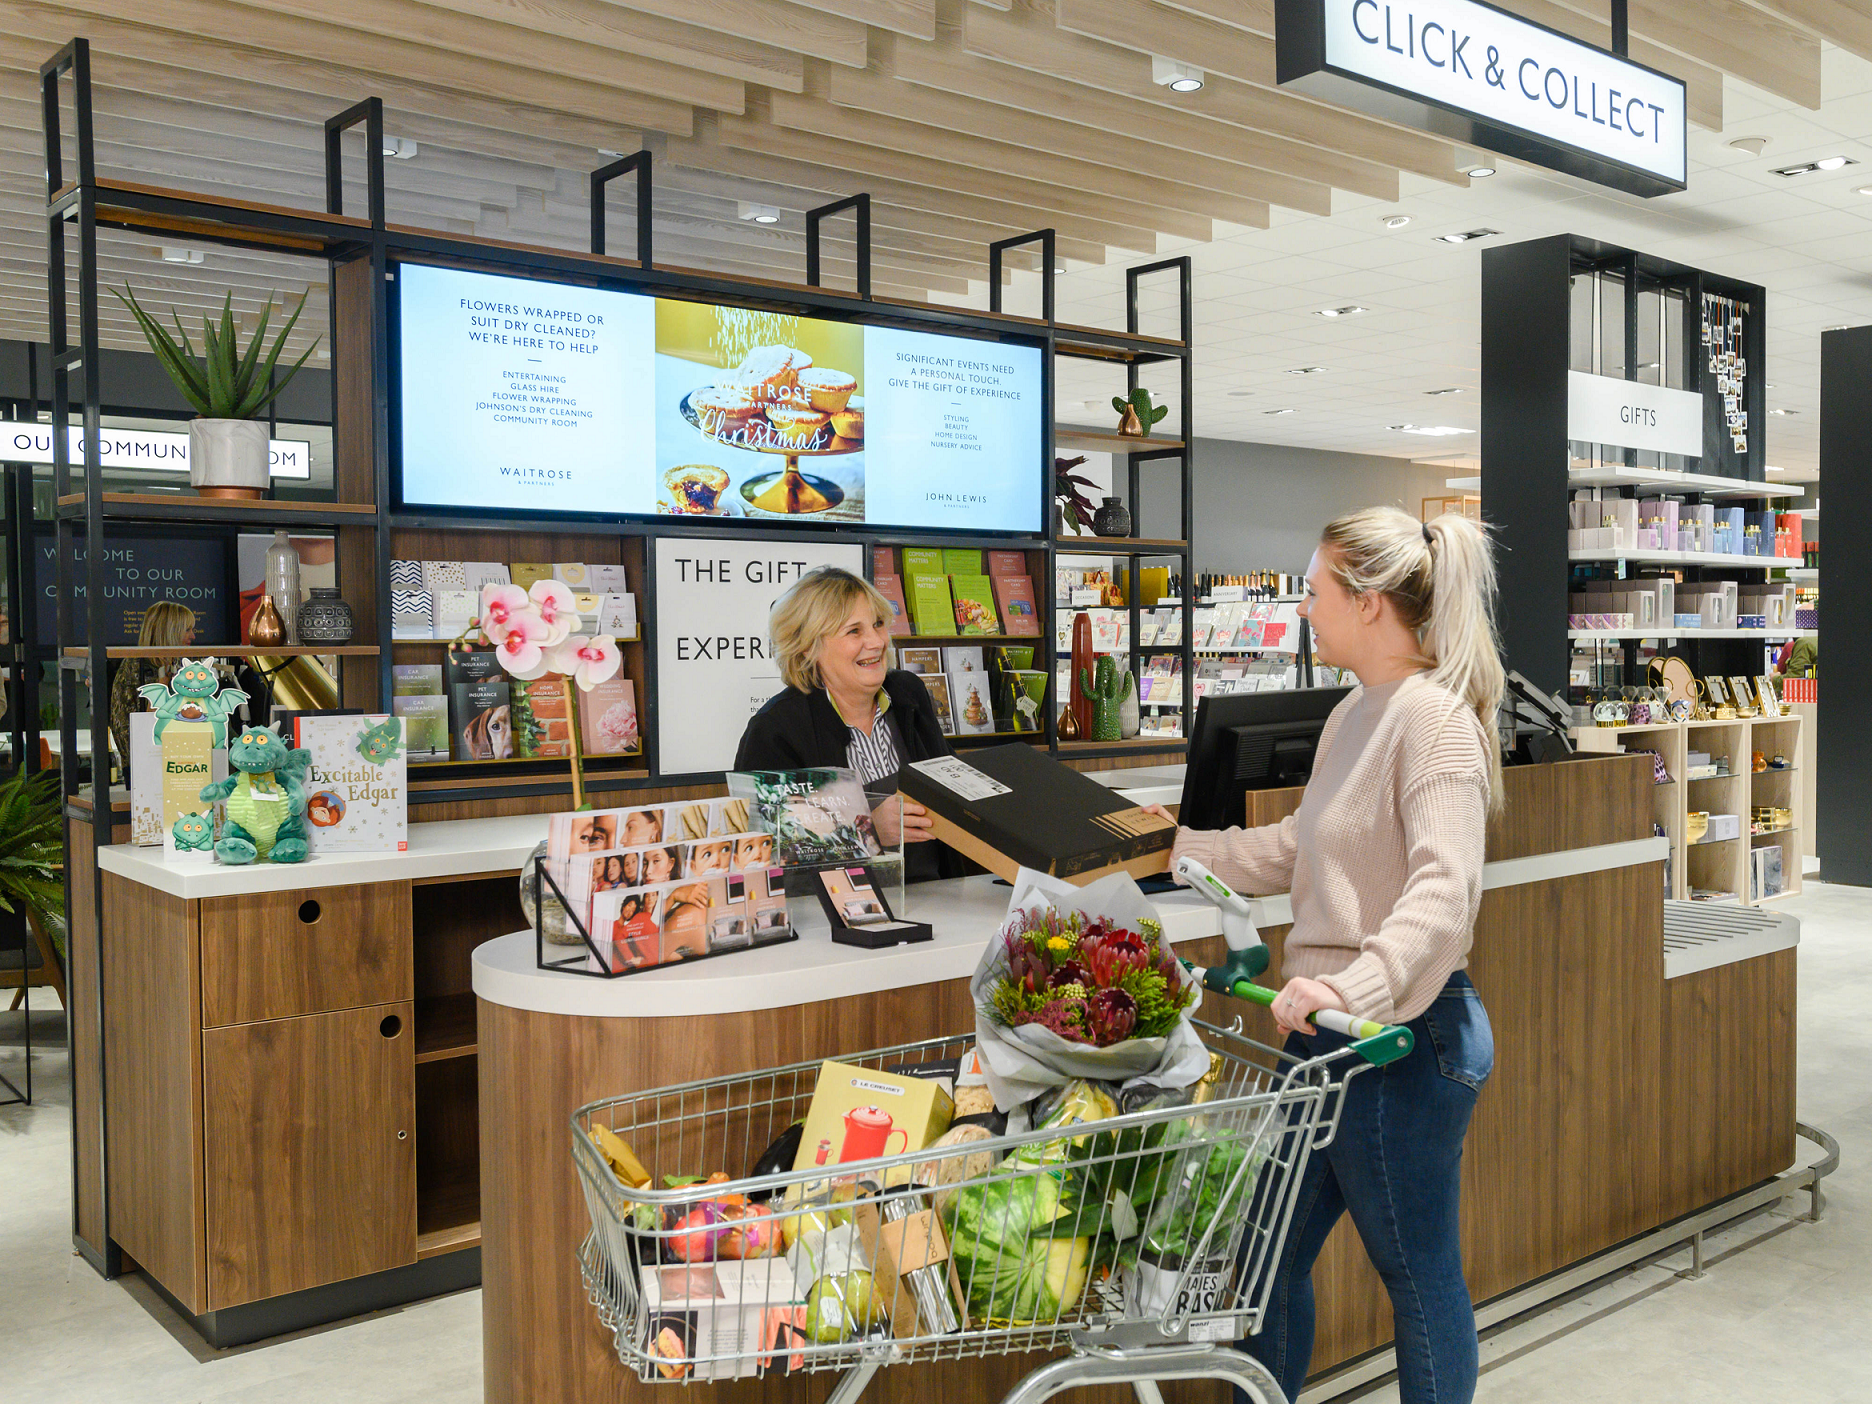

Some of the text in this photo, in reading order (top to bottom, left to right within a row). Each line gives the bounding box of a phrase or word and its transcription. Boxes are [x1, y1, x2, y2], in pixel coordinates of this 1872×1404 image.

[1352, 0, 1665, 144] CLICK & COLLECT
[460, 298, 604, 325] FLOWERS WRAPPED OR
[471, 316, 596, 340] SUIT DRY CLEANED?
[469, 331, 599, 354] WE'RE HERE TO HELP
[896, 352, 1015, 375] SIGNIFICANT EVENTS NEED
[502, 370, 566, 384] ENTERTAINING
[910, 367, 1002, 386] A PERSONAL TOUCH.
[510, 382, 560, 394] GLASS HIRE
[716, 378, 812, 403] WAITROSE
[888, 378, 1021, 400] GIVE THE GIFT OF EXPERIENCE
[492, 391, 577, 406] FLOWER WRAPPING
[751, 401, 792, 411] ARTNERS
[475, 401, 593, 418] JOHNSON'S DRY CLEANING
[1620, 405, 1656, 427] GIFTS
[493, 414, 578, 428] COMMUNITY ROOM
[943, 414, 970, 423] STYLING
[700, 408, 828, 452] Christmas
[944, 422, 969, 431] BEAUTY
[14, 434, 50, 451] OU
[934, 431, 978, 441] HOME DESIGN
[930, 441, 982, 452] NURSERY ADVICE
[499, 466, 572, 480] WAITROSE
[926, 492, 987, 504] JOHN LEWIS
[116, 567, 184, 581] TO OUR
[675, 559, 807, 584] THE GIFT
[45, 585, 216, 600] CMUNITY ROOM
[677, 637, 772, 660] EXPERI
[166, 761, 208, 774] EDGAR
[309, 764, 383, 784] Excitable
[347, 782, 399, 808] Edgar
[773, 782, 818, 795] TASTE.
[805, 796, 850, 808] LEARN.
[794, 811, 846, 825] CREATE.
[870, 1083, 900, 1093] CREUSET
